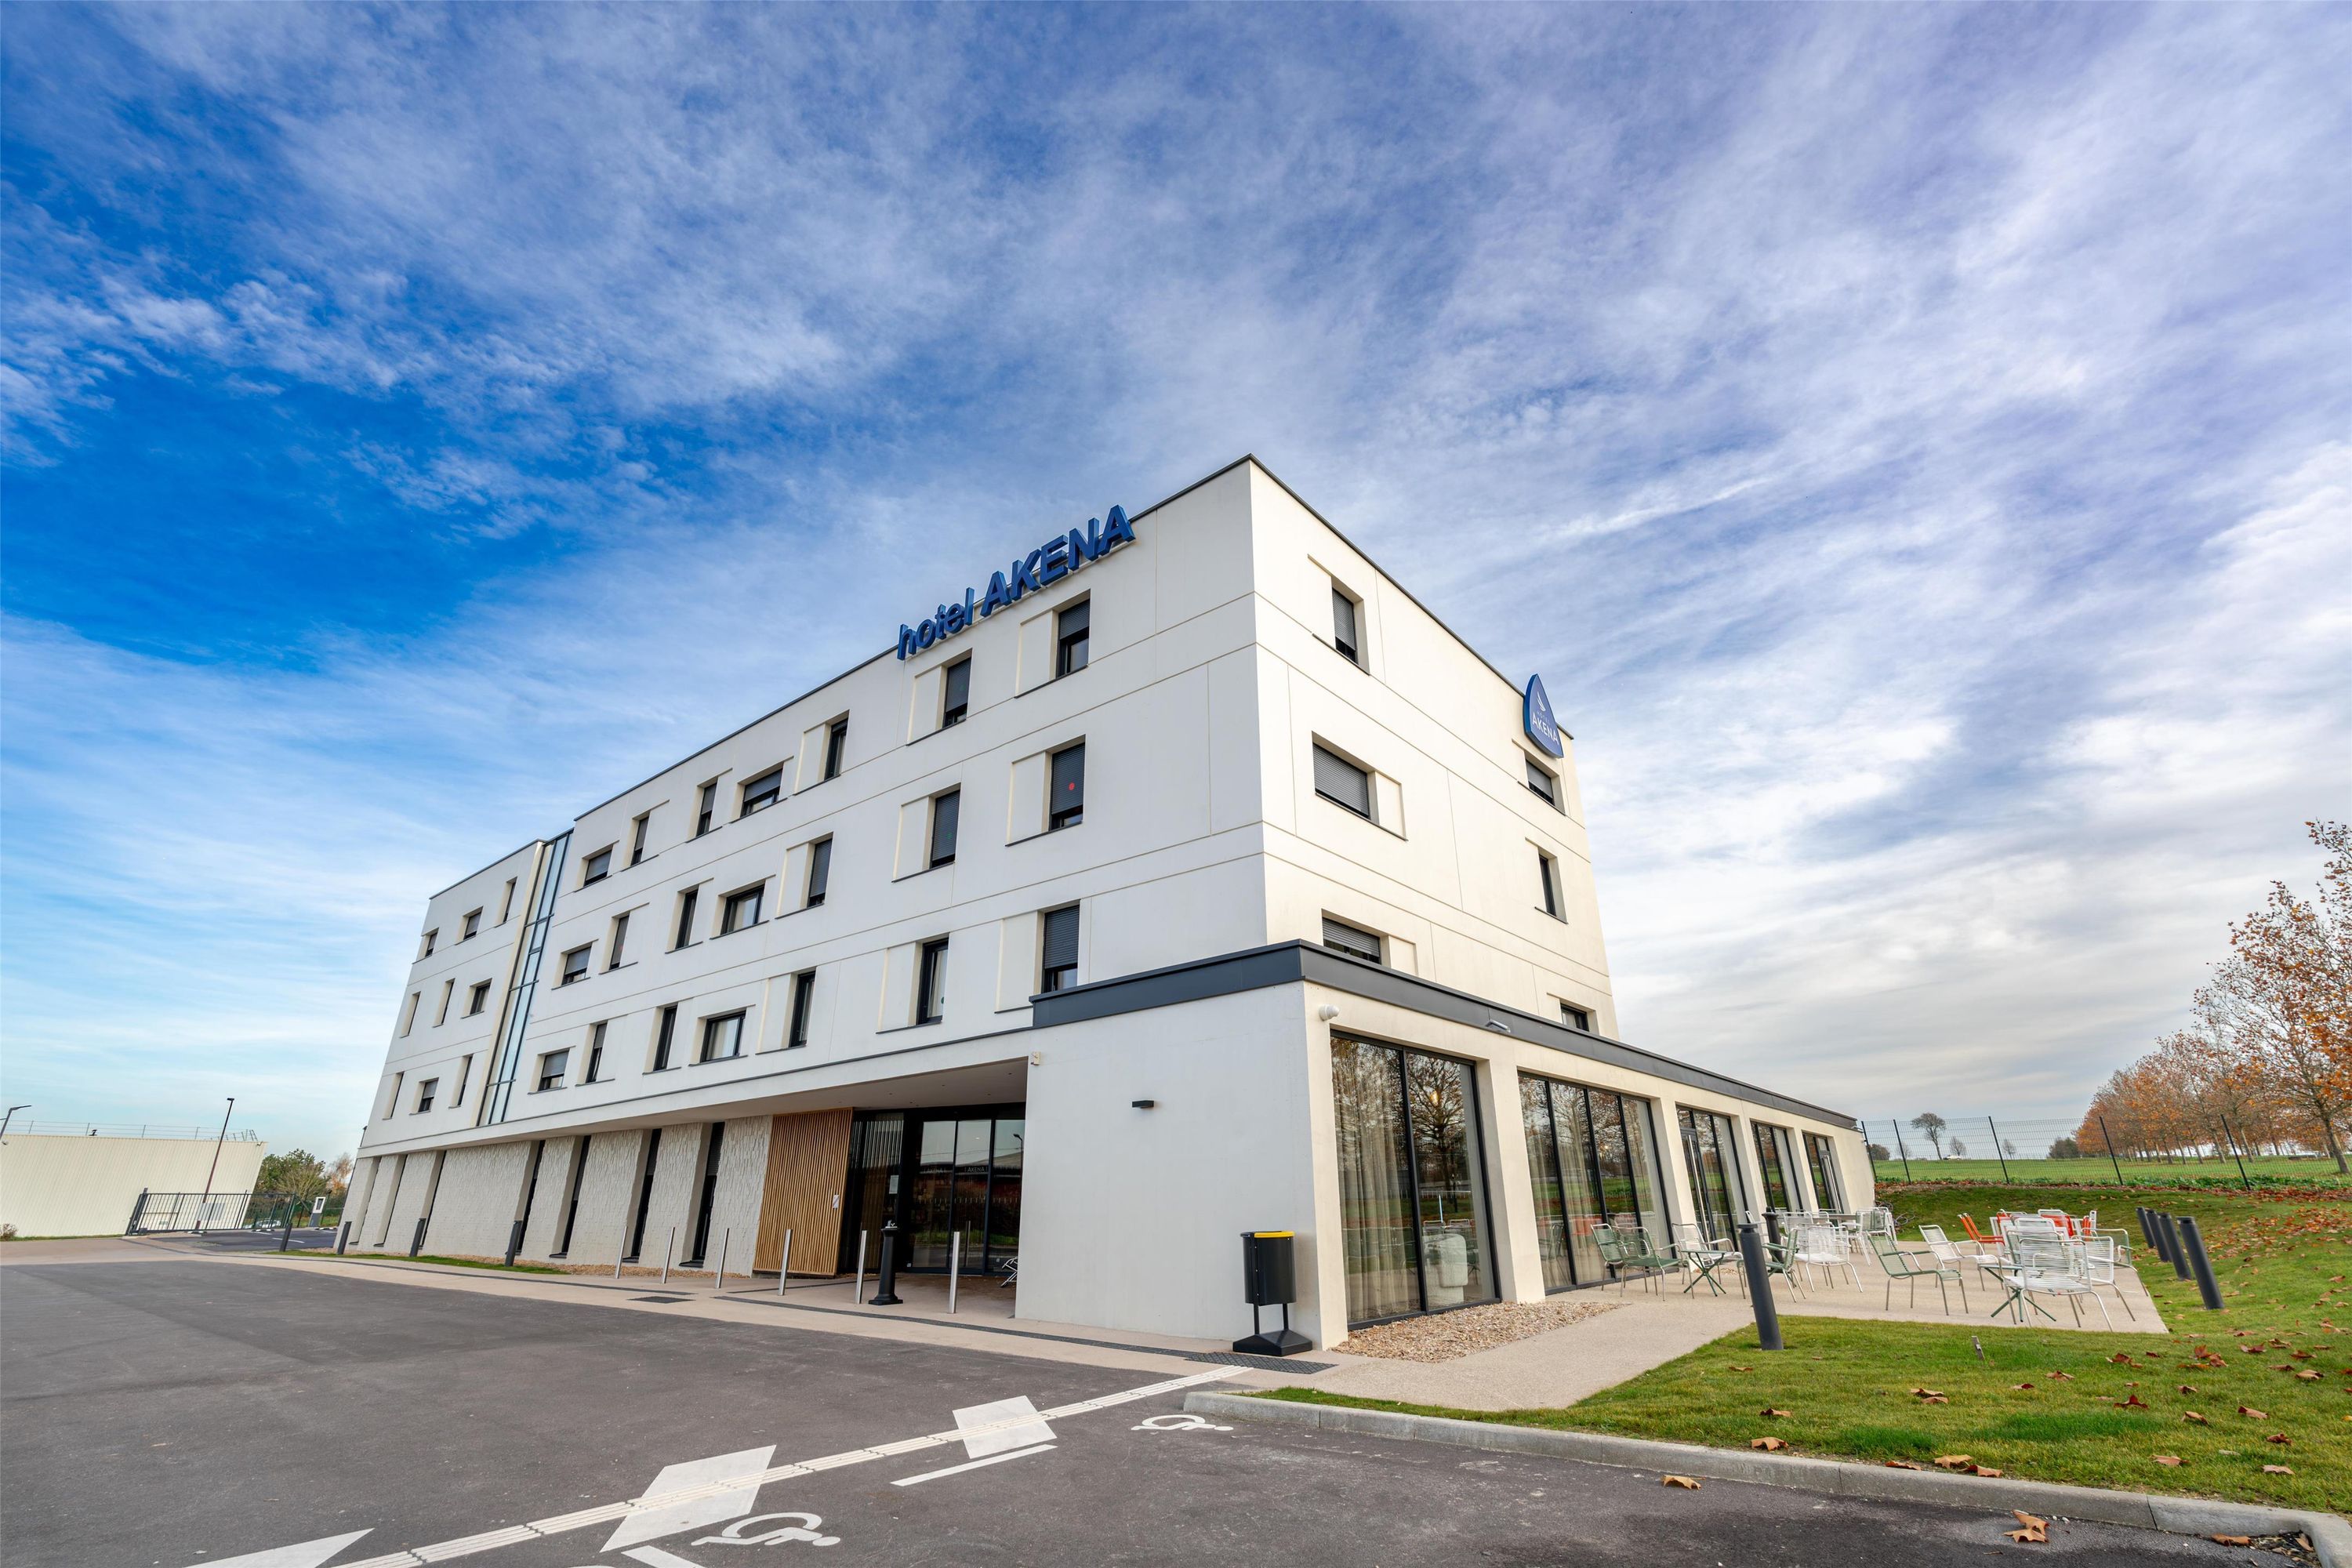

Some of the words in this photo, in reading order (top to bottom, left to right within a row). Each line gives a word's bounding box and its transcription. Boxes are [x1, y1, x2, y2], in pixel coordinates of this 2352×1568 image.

[897, 587, 975, 660] hotel
[980, 504, 1136, 618] AKENA
[1533, 712, 1559, 746] AKENA
